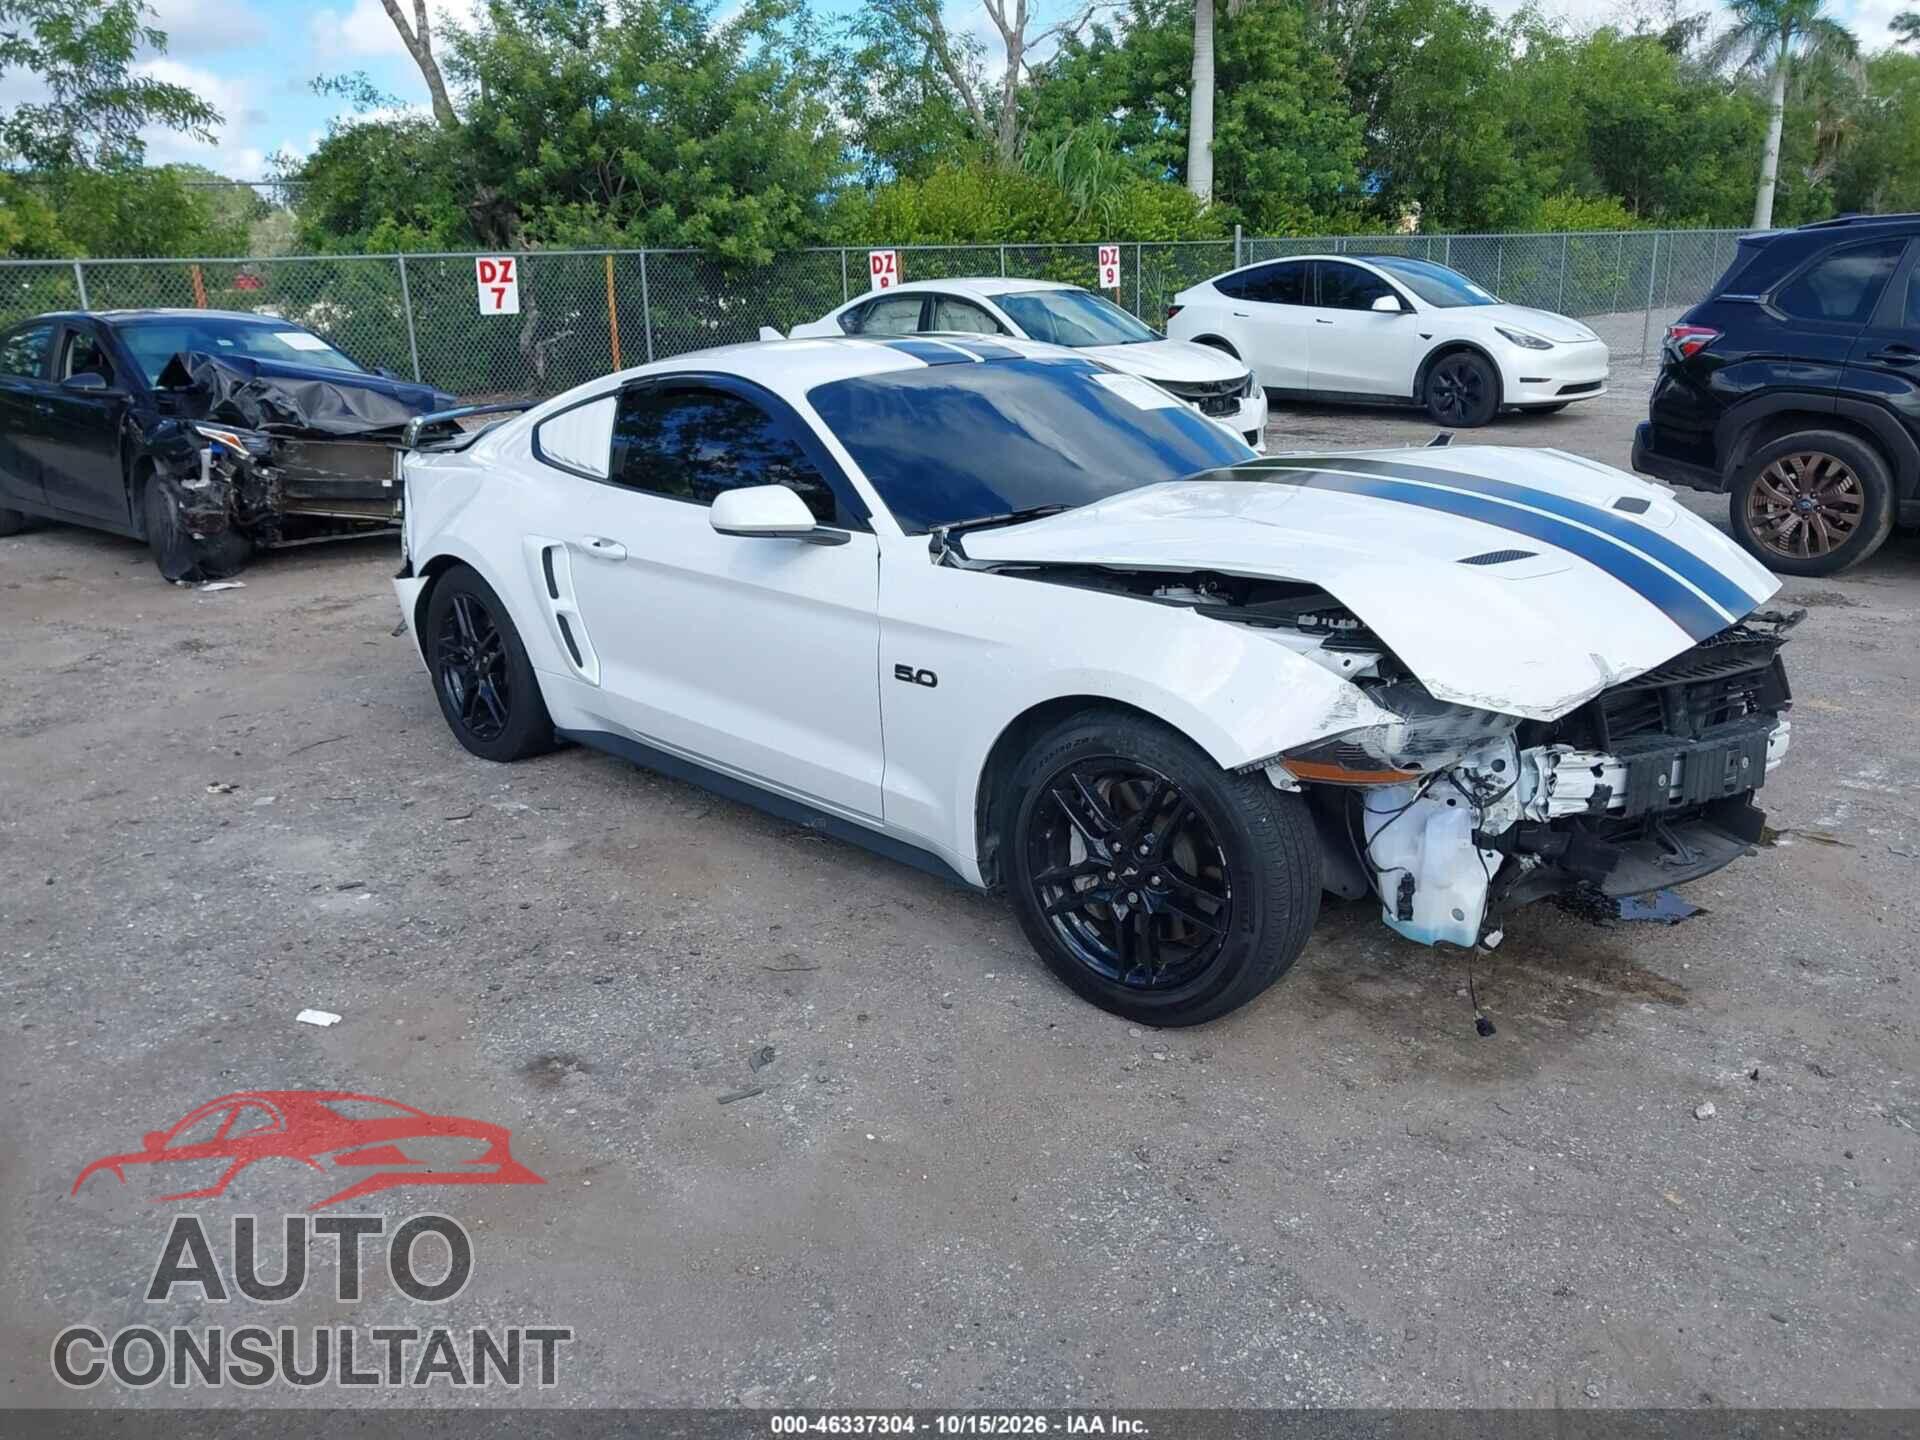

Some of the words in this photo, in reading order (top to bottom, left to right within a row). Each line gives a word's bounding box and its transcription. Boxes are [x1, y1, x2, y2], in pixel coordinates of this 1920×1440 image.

[872, 254, 895, 274] DZ
[1100, 249, 1118, 265] DZ
[479, 260, 513, 283] DZ
[1106, 267, 1115, 284] 9
[490, 287, 506, 309] 7
[894, 663, 938, 688] 5.0
